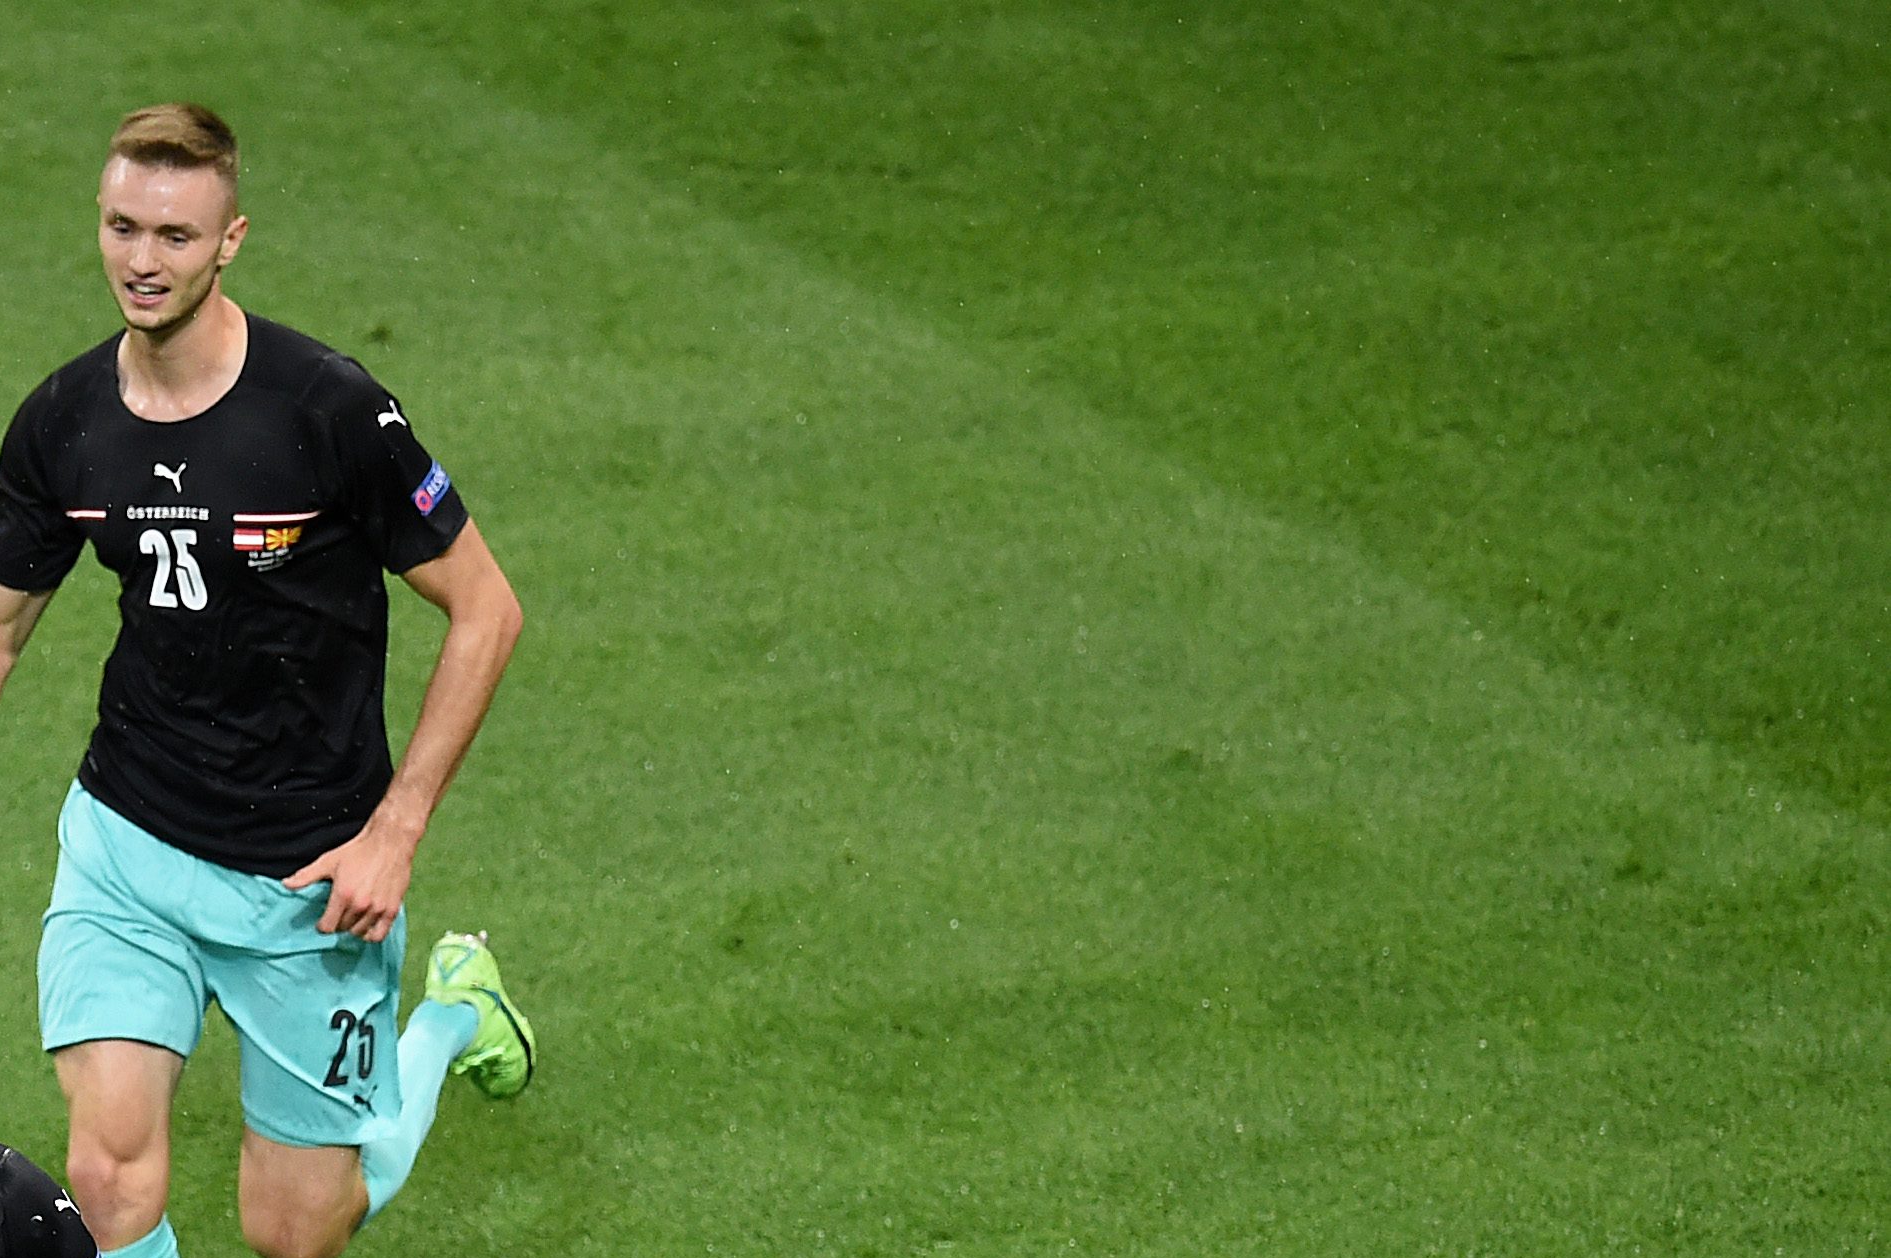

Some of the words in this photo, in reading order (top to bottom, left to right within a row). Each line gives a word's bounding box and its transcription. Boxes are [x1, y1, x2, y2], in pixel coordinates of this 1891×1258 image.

[127, 505, 209, 520] ÖSTERREICH
[139, 529, 208, 611] 25
[323, 1009, 375, 1087] 25
